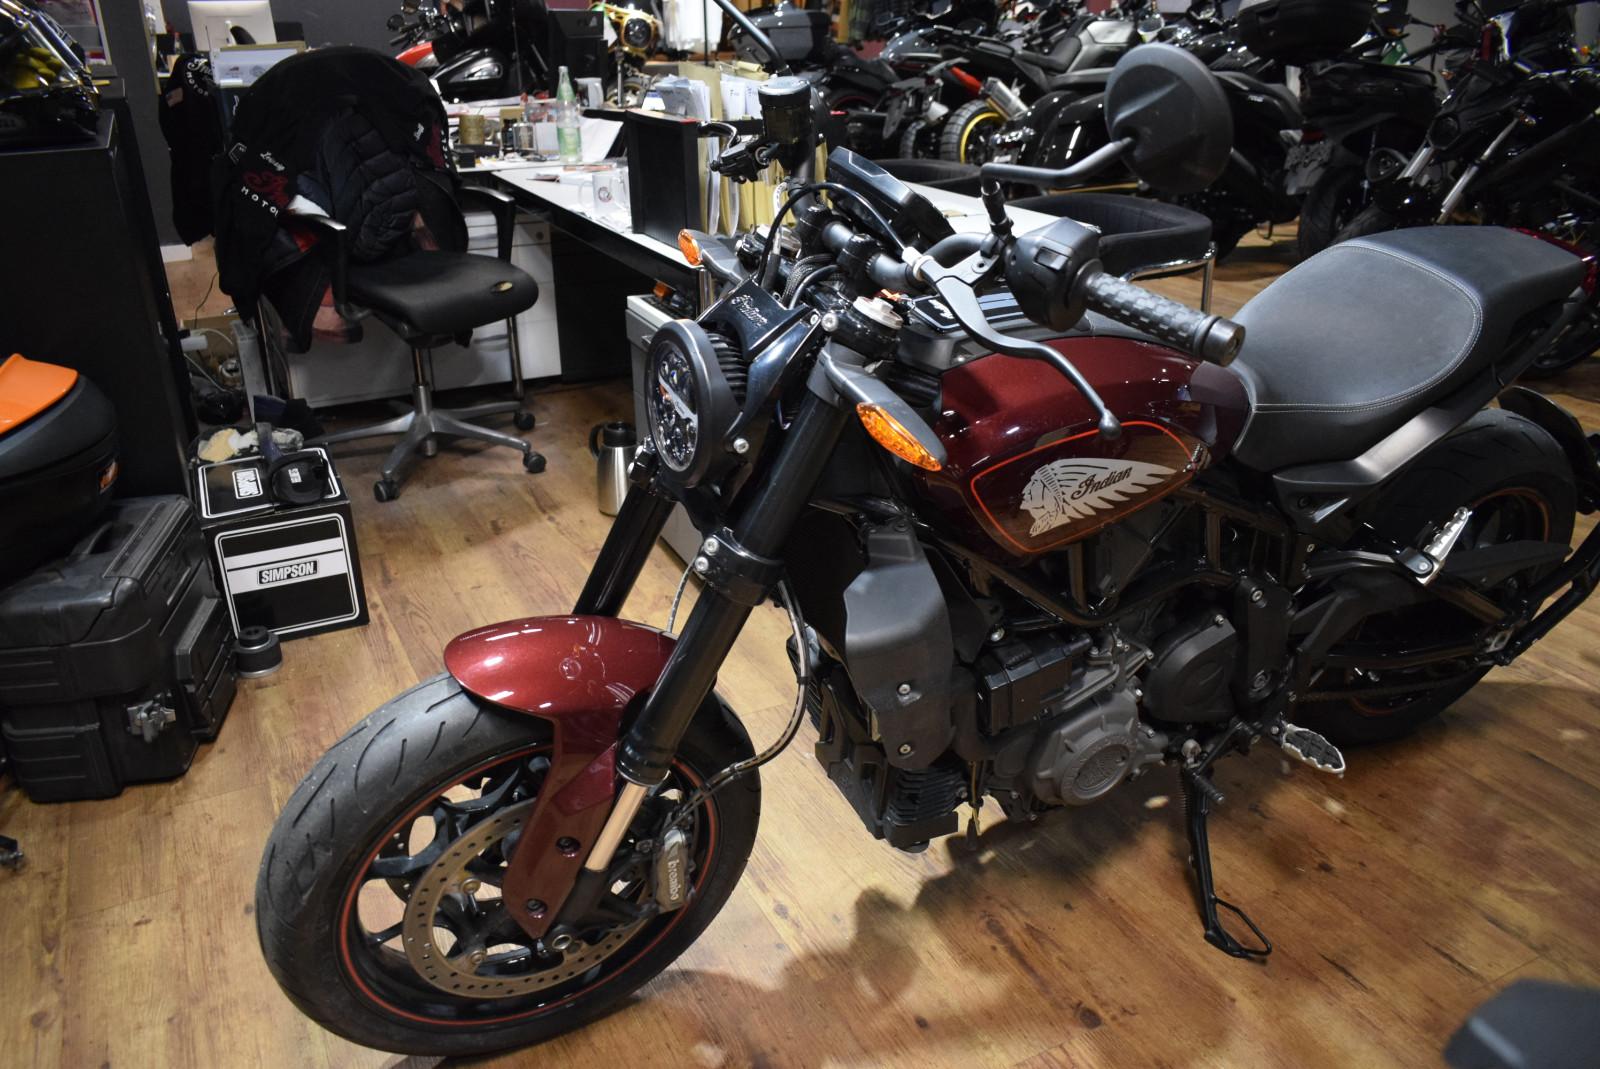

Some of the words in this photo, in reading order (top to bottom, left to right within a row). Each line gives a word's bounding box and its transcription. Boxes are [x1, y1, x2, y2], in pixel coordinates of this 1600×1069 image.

[1070, 466, 1133, 500] Indian
[261, 561, 315, 584] SIMPSON
[667, 858, 682, 901] brembo
